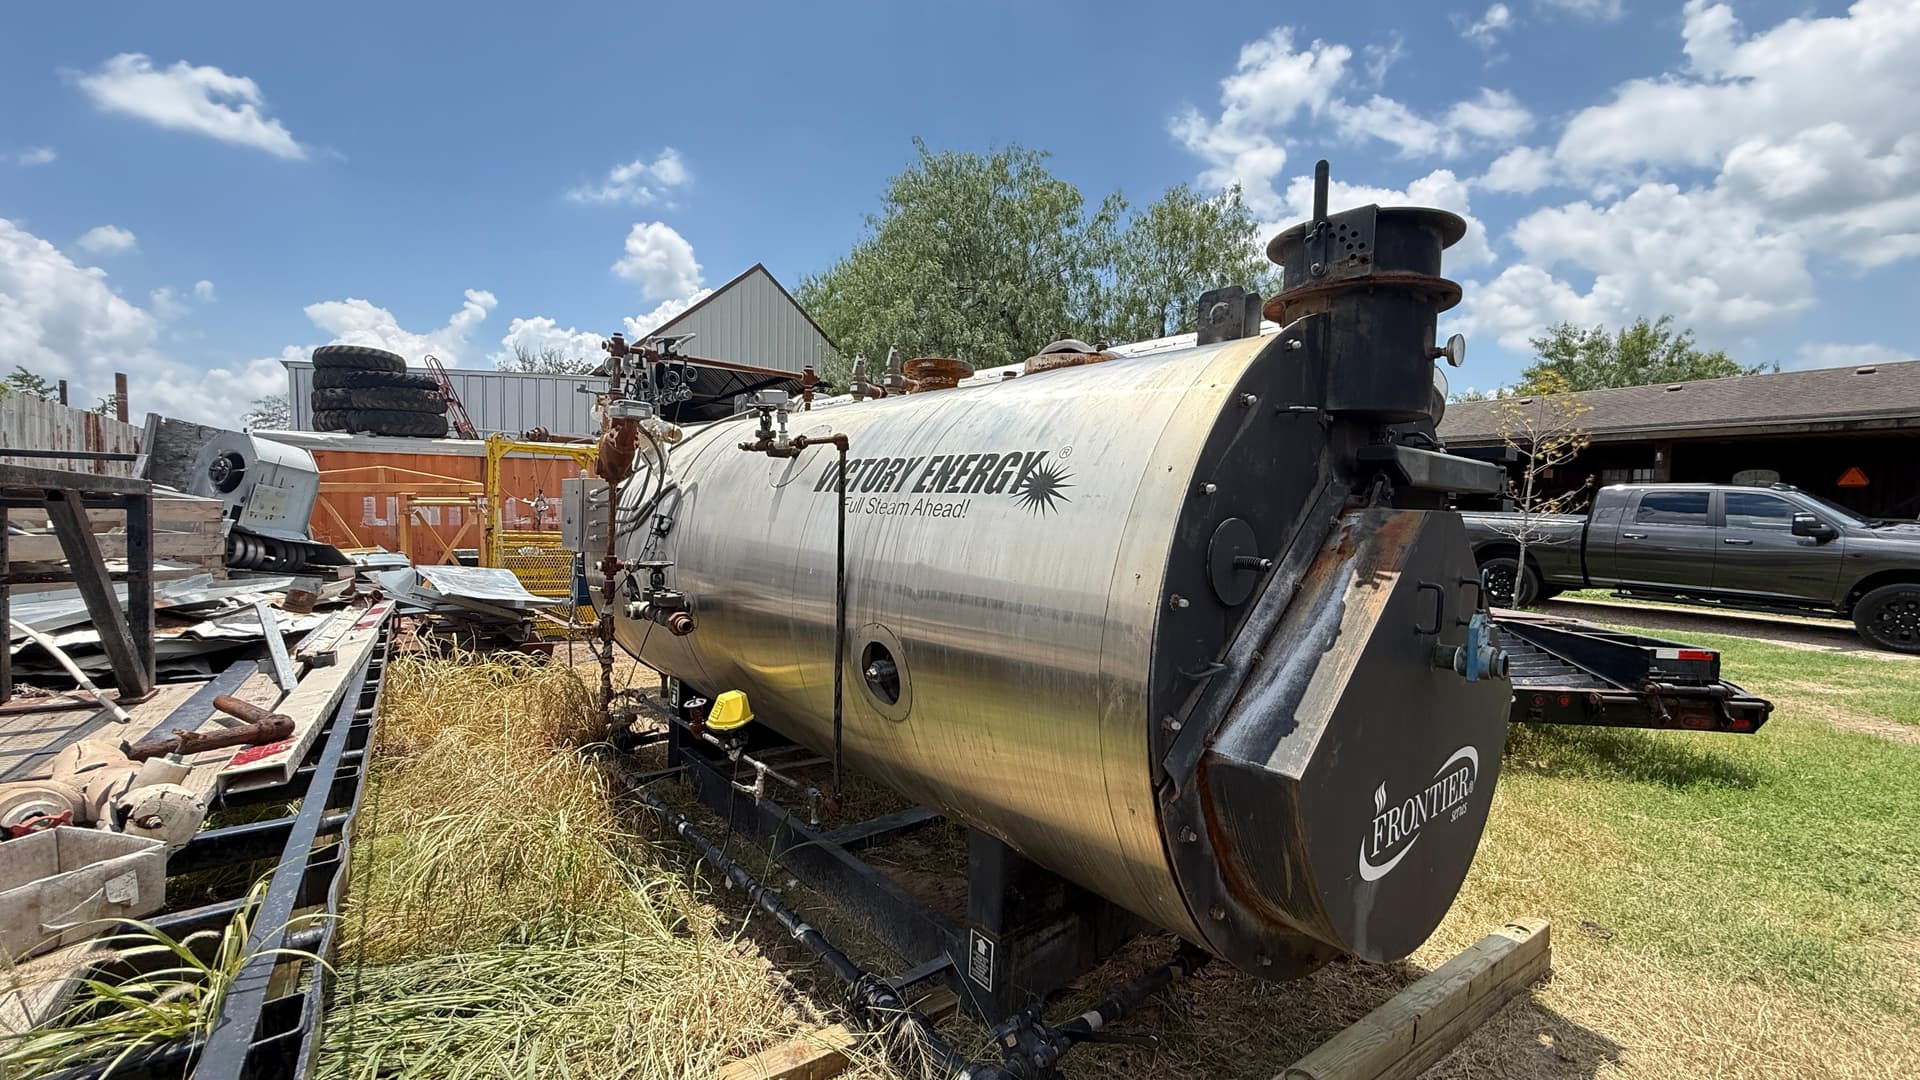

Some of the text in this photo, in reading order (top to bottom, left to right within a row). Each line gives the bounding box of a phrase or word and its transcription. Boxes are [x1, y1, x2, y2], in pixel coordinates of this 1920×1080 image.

[911, 451, 1050, 495] ENERGY
[865, 496, 909, 516] Steam
[910, 498, 971, 519] Ahead!
[1370, 766, 1469, 858] FRONTIER
